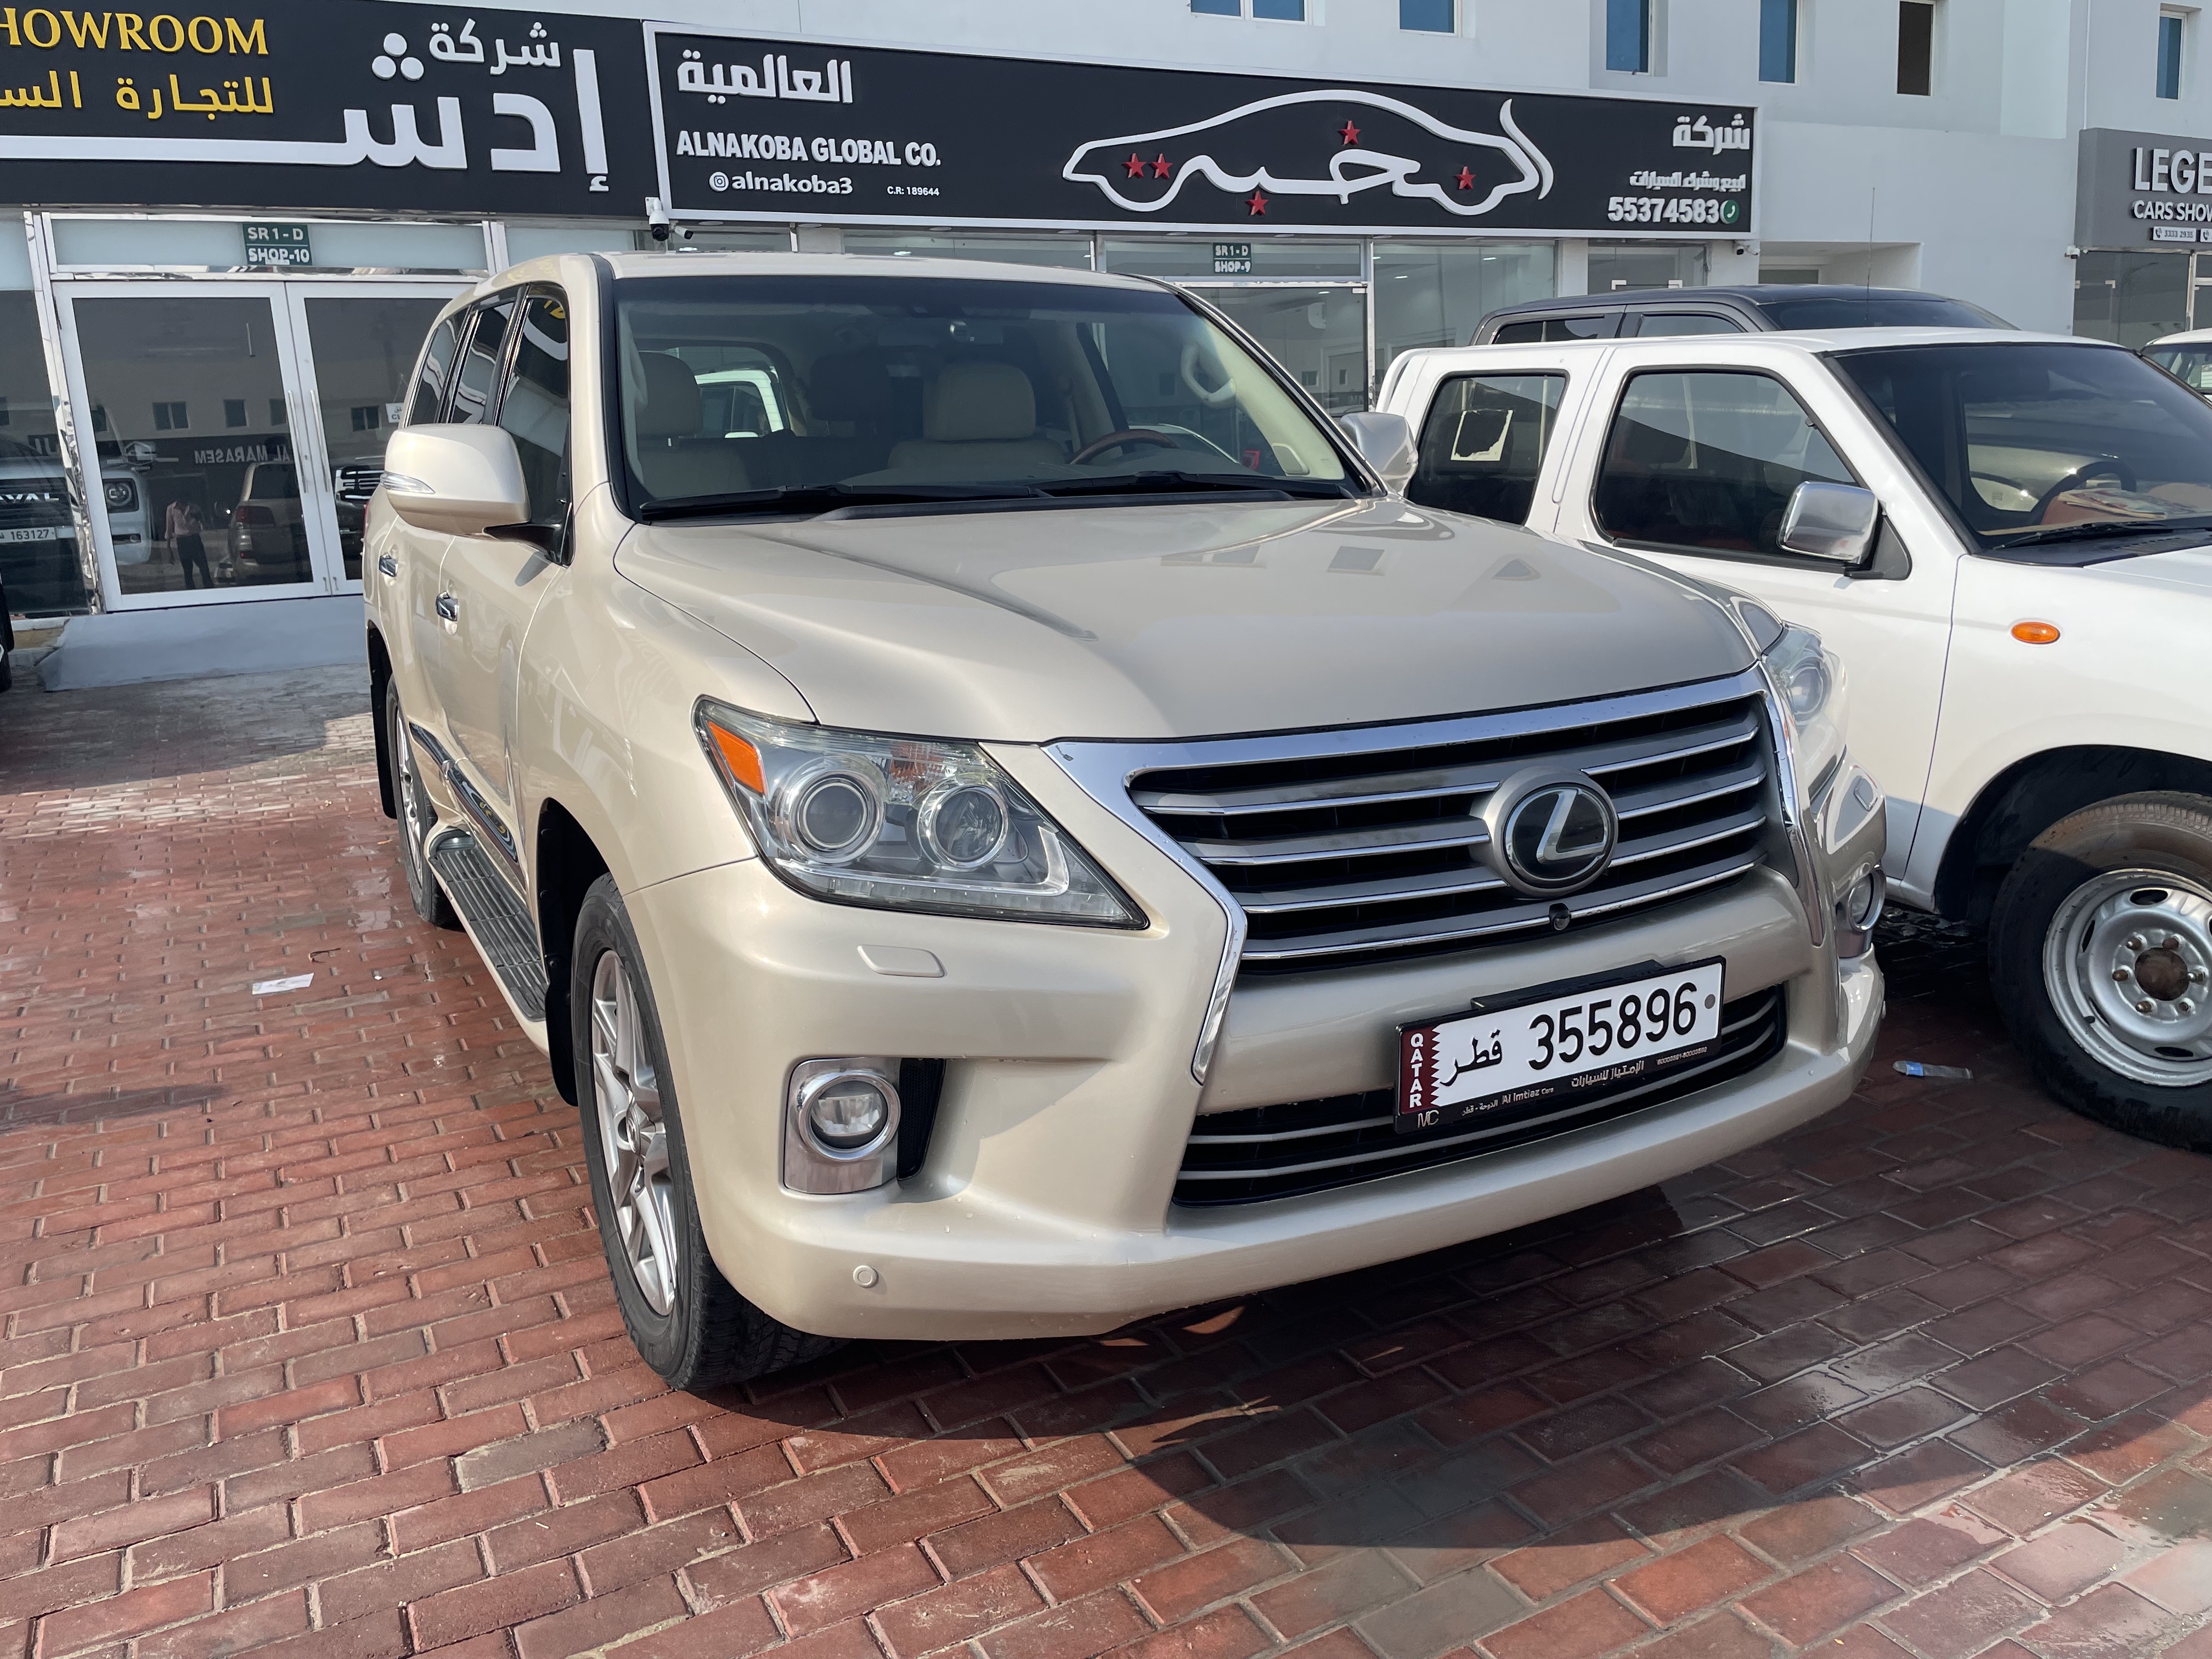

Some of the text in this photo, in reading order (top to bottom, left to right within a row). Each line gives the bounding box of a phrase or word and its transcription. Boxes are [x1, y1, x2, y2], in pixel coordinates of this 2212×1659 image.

[428, 19, 560, 76] شركة
[677, 49, 853, 105] العالمية
[116, 74, 274, 120] للتجارة
[676, 130, 941, 167] ALNAKOBA GLOBAL CO.
[1673, 114, 1751, 155] شركة
[906, 187, 940, 196] 189644
[1607, 196, 1719, 224] 55374583
[2134, 200, 2174, 220] CARS
[247, 227, 269, 241] SR
[1215, 245, 1228, 256] SR
[10, 529, 49, 540] 163127
[1527, 982, 1697, 1071] 355896
[1409, 1032, 1424, 1108] QATAR
[1439, 1029, 1503, 1087] قطر
[1513, 1088, 1540, 1103] Imtiaz
